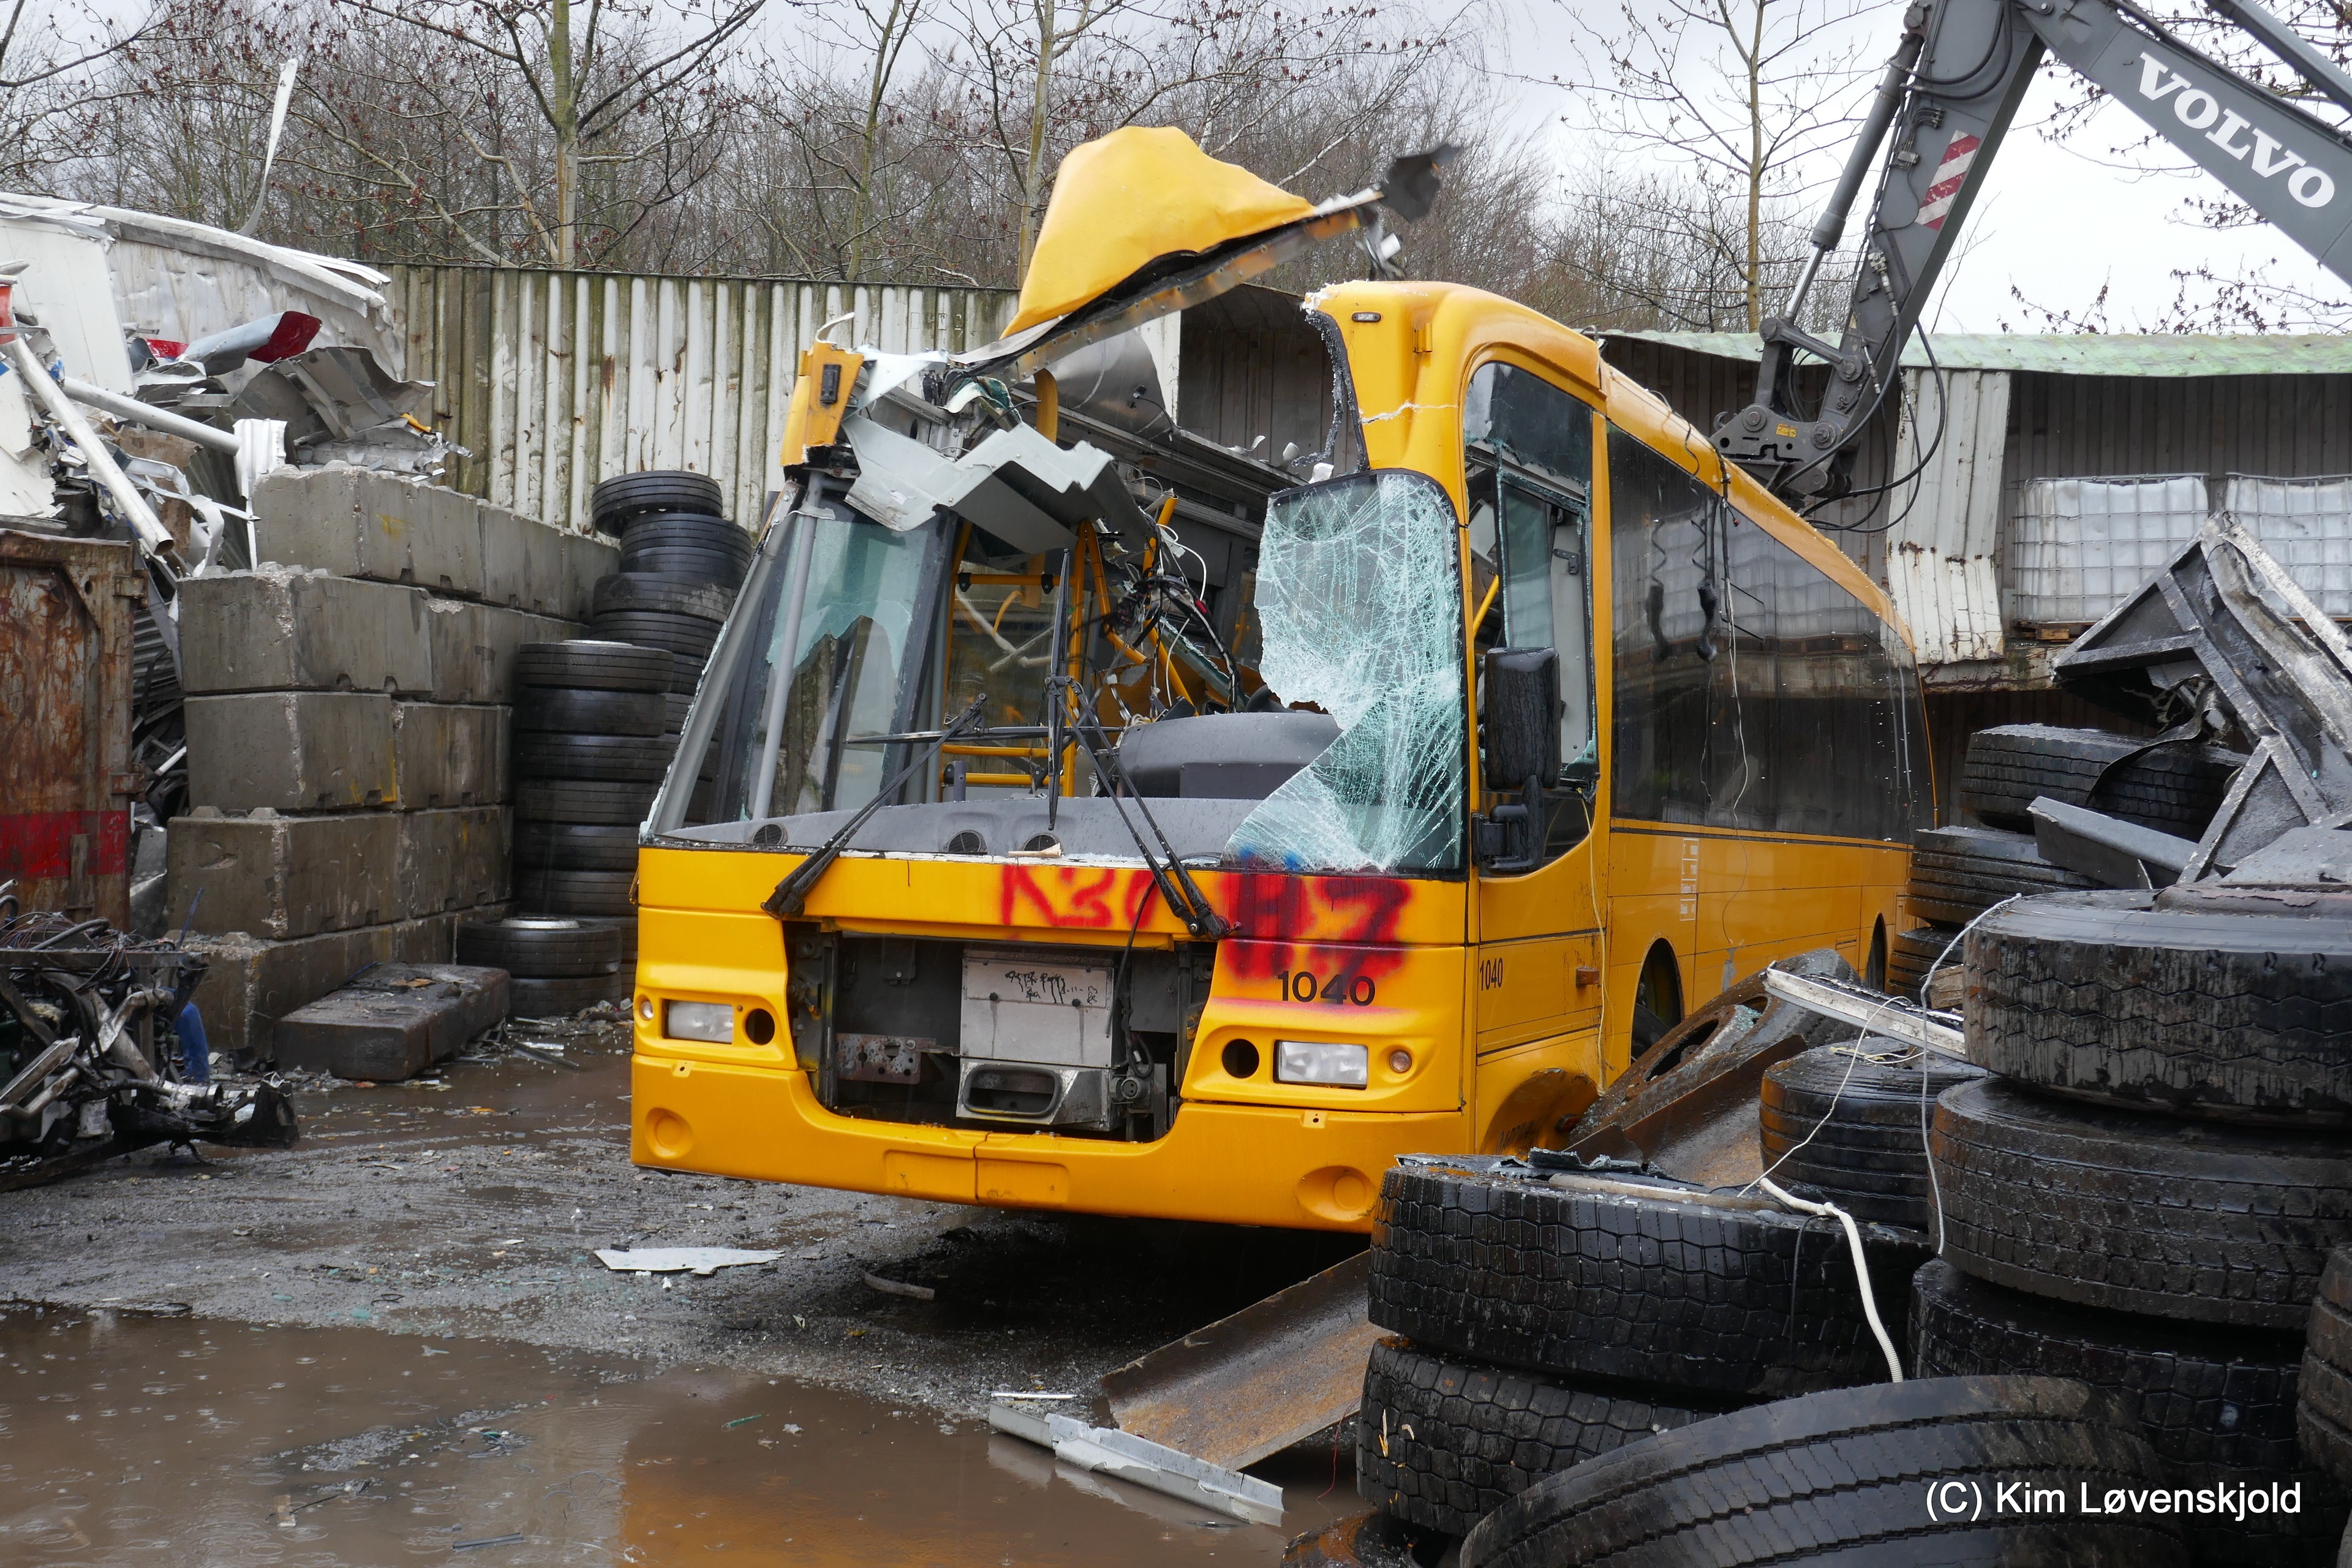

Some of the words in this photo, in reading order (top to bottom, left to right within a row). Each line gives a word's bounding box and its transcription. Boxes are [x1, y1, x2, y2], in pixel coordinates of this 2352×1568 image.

[2139, 52, 2335, 208] VOLVO
[1278, 970, 1376, 1006] 1040
[1479, 957, 1504, 991] 1040
